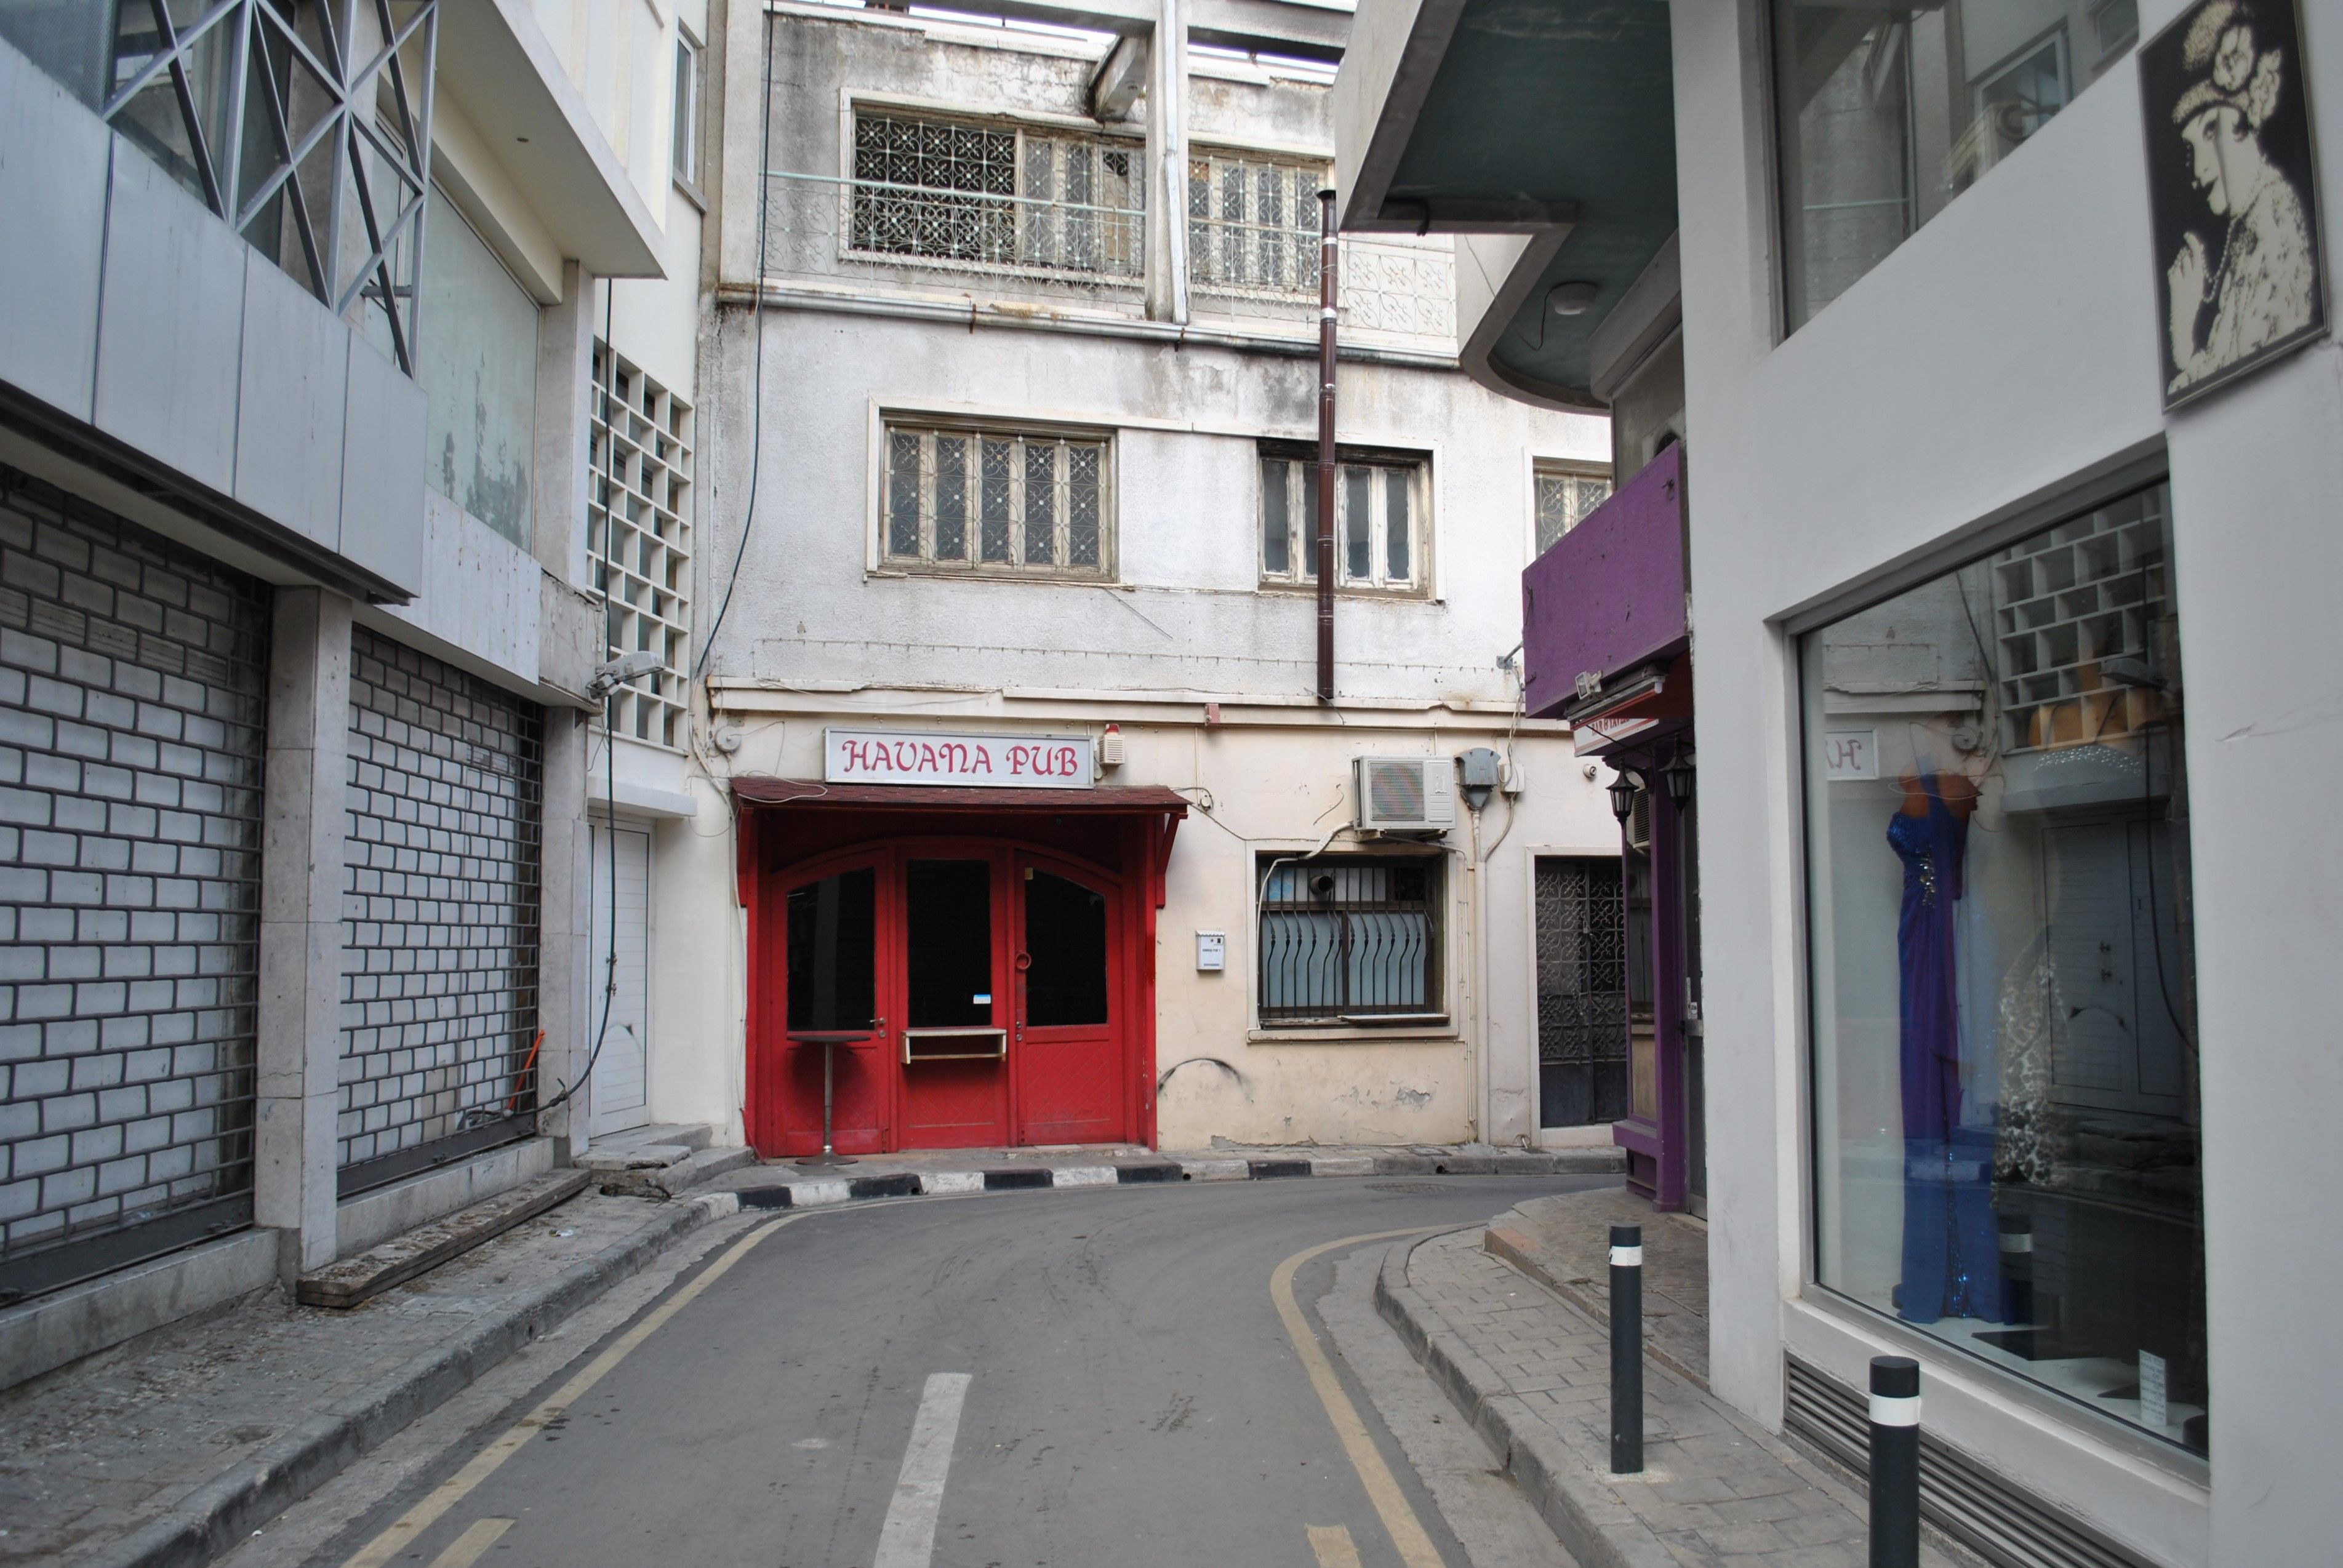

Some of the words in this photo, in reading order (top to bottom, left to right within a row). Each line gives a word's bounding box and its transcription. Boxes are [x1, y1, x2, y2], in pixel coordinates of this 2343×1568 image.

[1591, 720, 1604, 736] BAR
[841, 740, 993, 774] HAVANA
[1006, 745, 1078, 777] PUB
